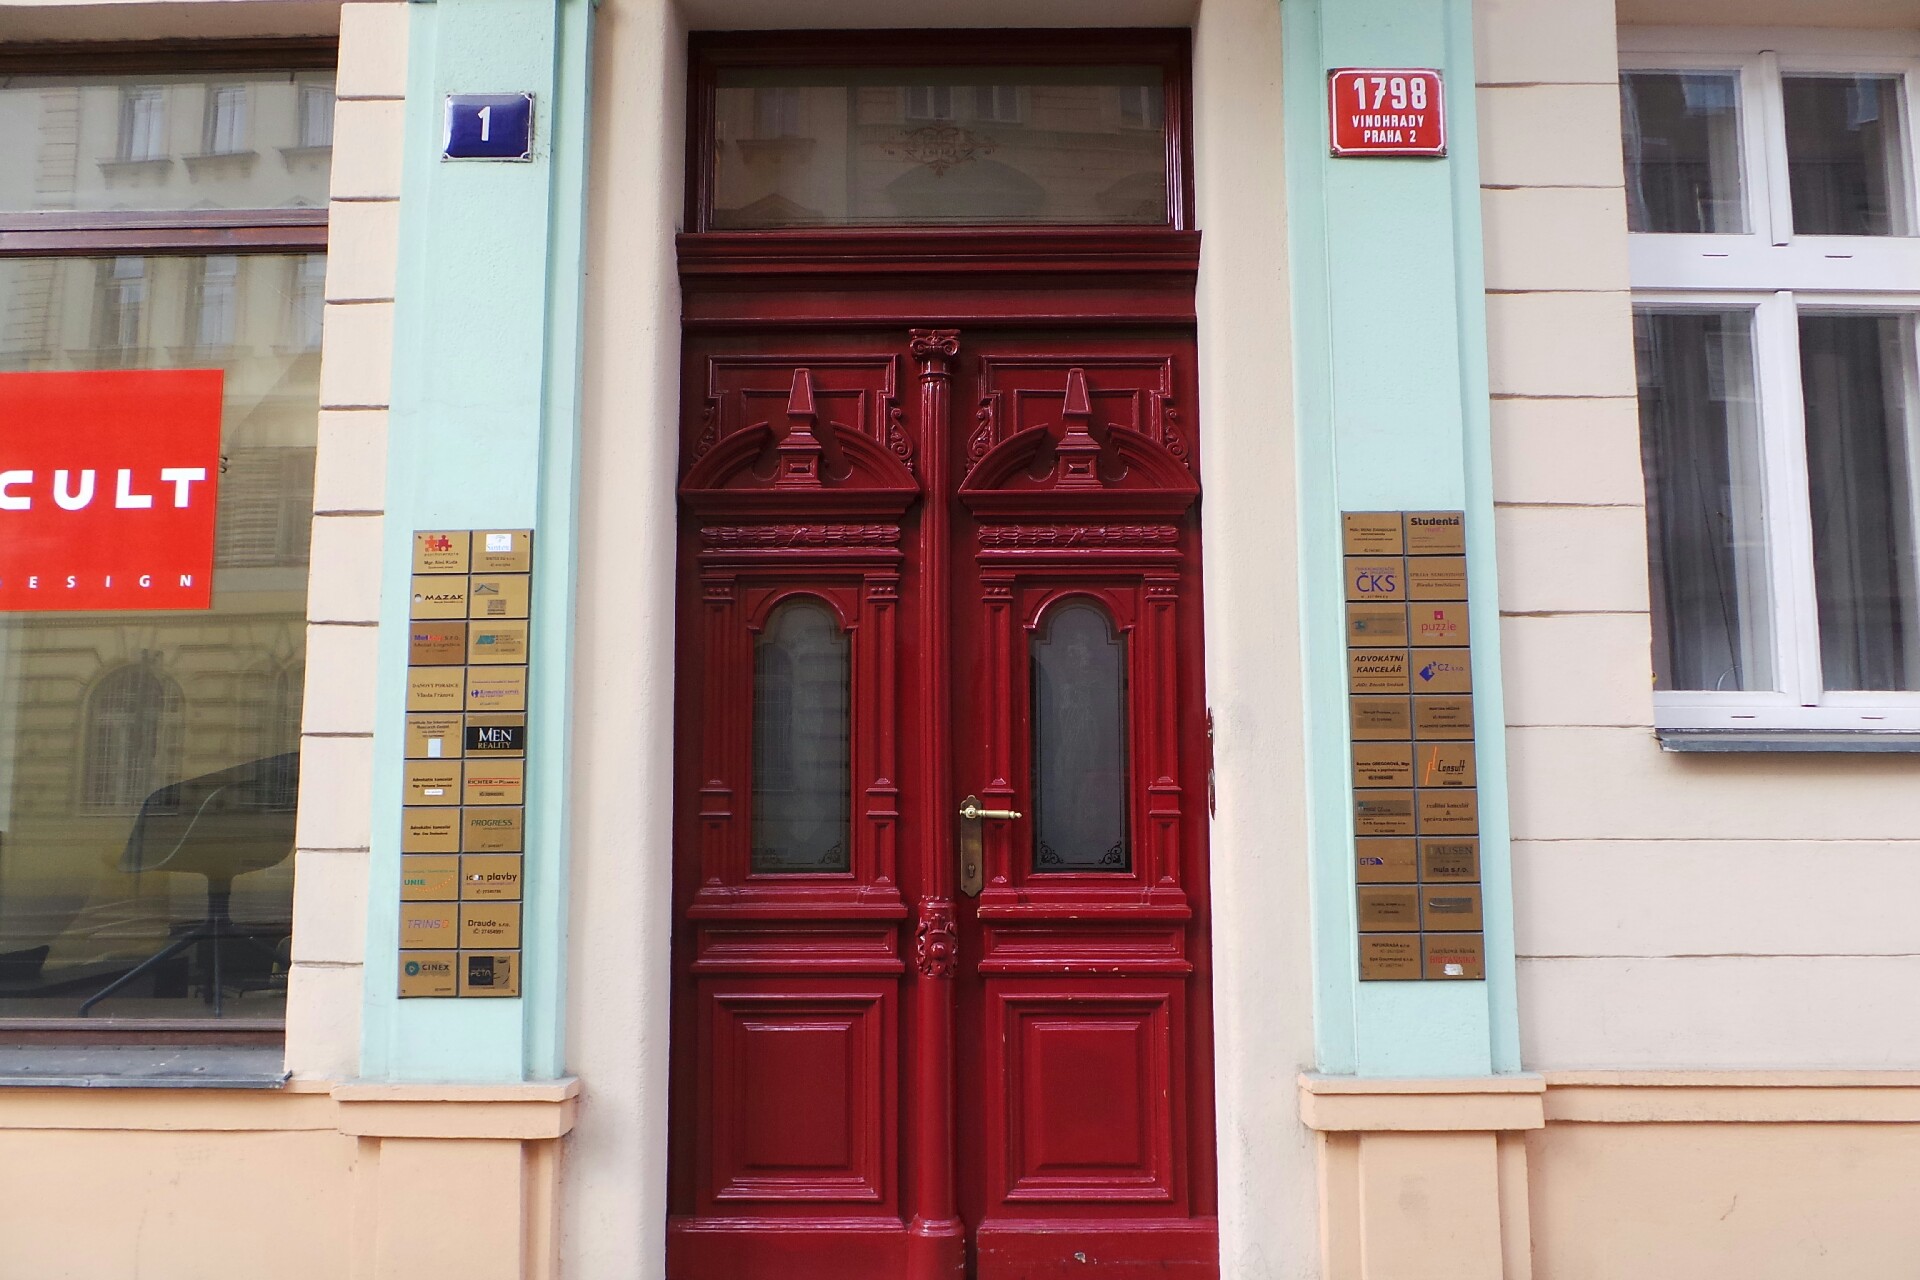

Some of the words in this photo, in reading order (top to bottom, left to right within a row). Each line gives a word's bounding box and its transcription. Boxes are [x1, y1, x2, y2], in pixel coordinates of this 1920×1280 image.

[1353, 77, 1427, 110] 1798
[477, 106, 490, 141] 1
[1352, 115, 1424, 128] VINOHRADY
[1364, 130, 1403, 143] PRAHA
[1409, 130, 1417, 143] 2
[0, 468, 206, 511] CULT
[1411, 517, 1460, 526] Studenta
[0, 575, 192, 588] ESIGN
[1356, 571, 1396, 592] ČKS
[1421, 620, 1456, 633] puzzle
[1354, 654, 1405, 662] ADVOKÁTNÍ
[1356, 665, 1402, 673] KANCELÁŘ
[1437, 663, 1450, 672] CZ
[479, 727, 513, 742] MEN
[471, 819, 513, 827] PROGRESS
[1360, 857, 1376, 866] GTS
[486, 871, 518, 883] plavby
[467, 919, 497, 927] Draude
